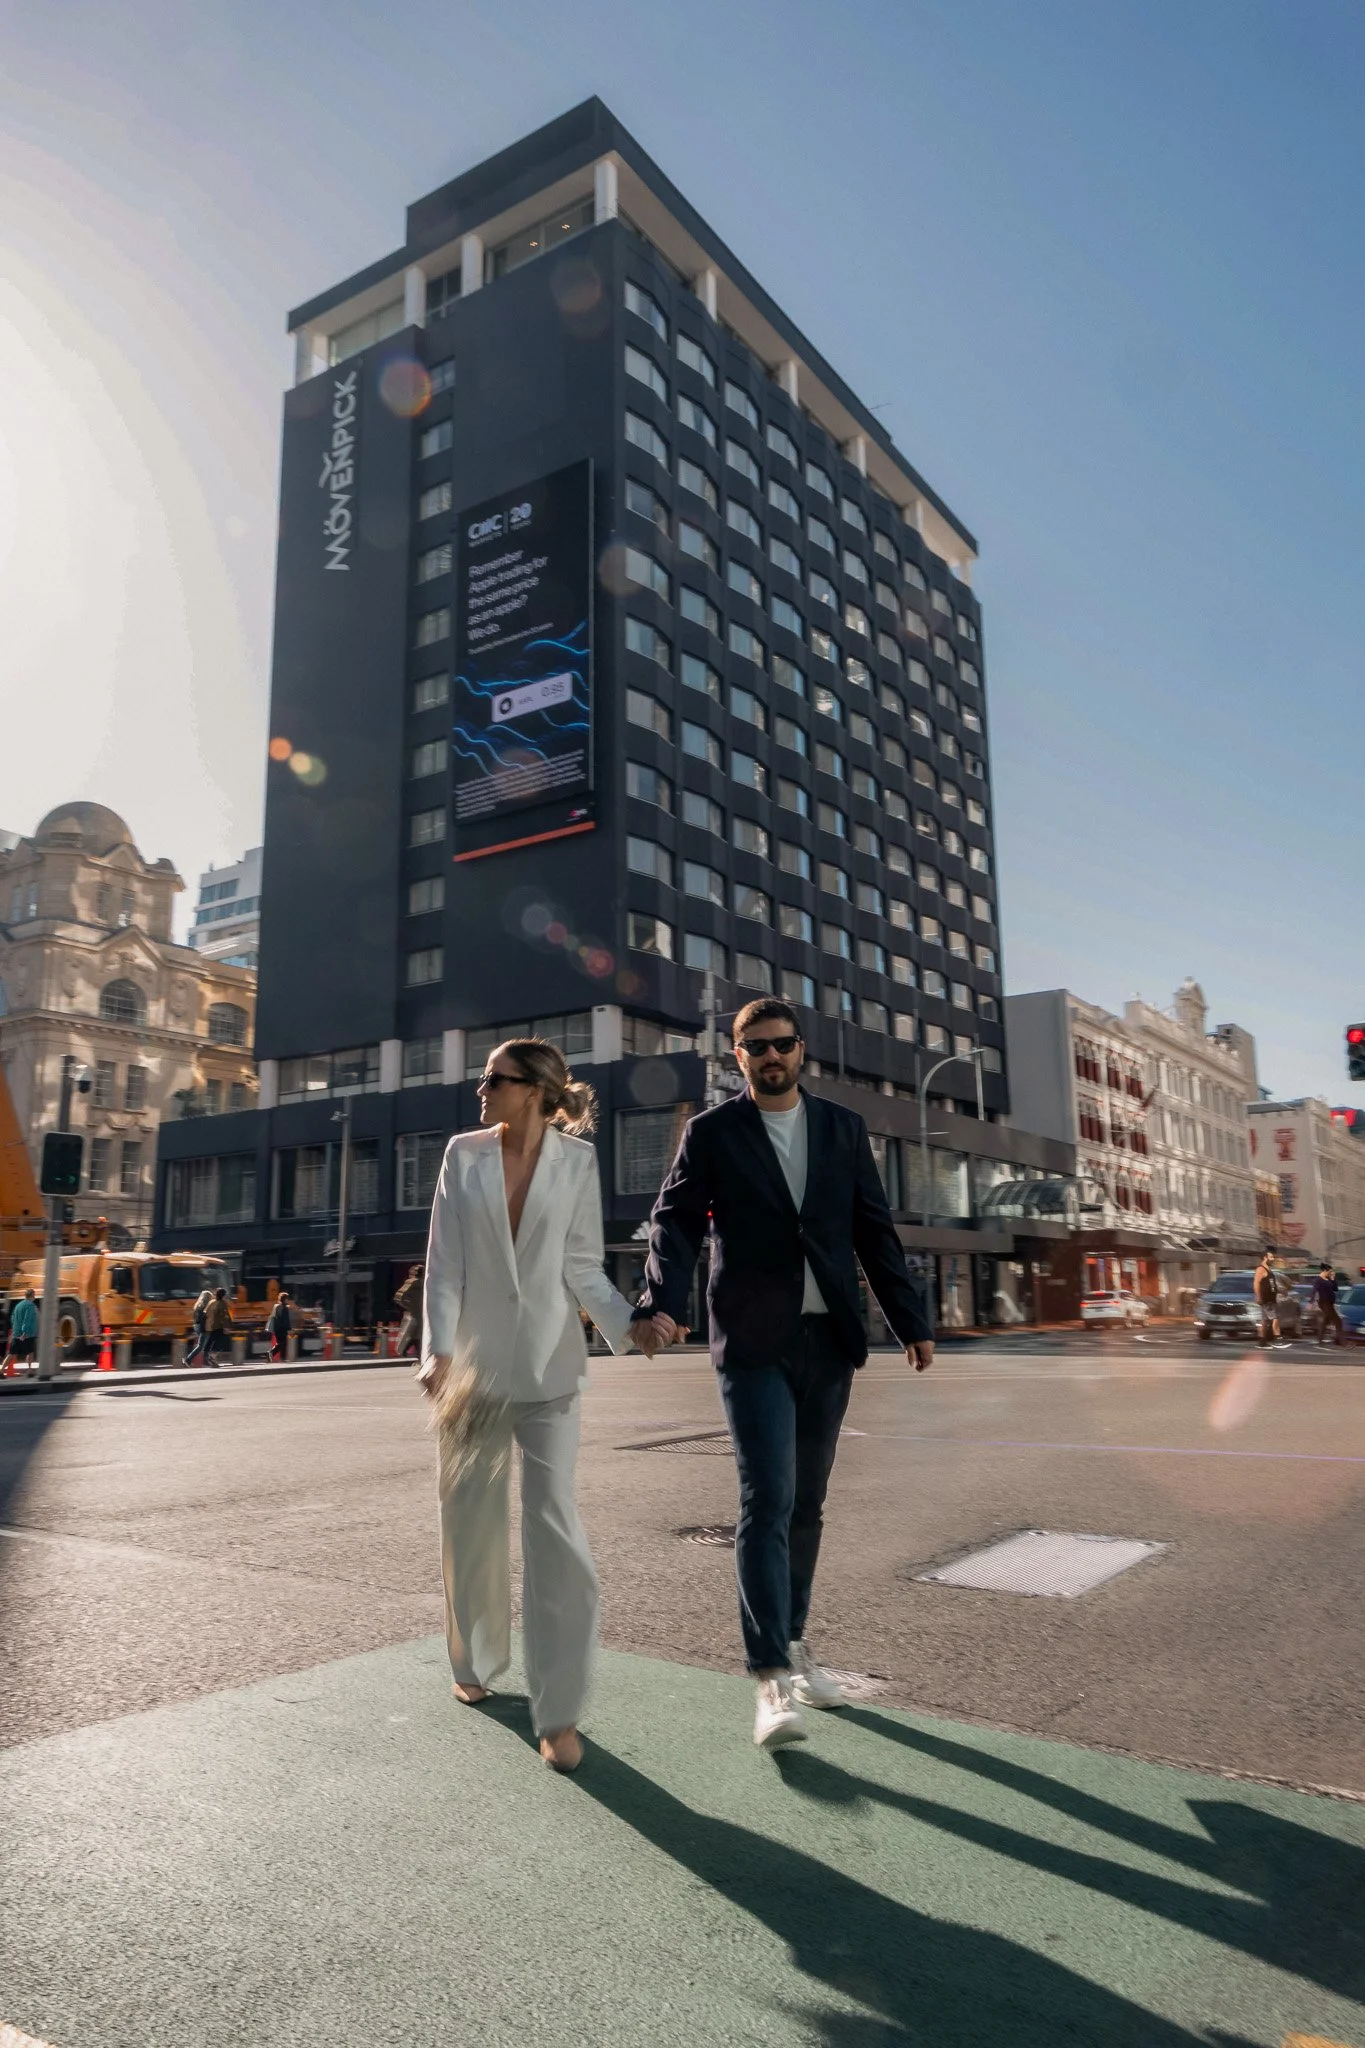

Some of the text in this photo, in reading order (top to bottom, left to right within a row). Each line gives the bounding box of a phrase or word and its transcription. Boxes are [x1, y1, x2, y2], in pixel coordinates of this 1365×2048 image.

[321, 370, 357, 571] MÖVENPICK
[468, 502, 533, 540] CMC 20
[468, 550, 524, 578] Remember
[468, 556, 549, 594] Apple trading for
[468, 596, 486, 609] the
[485, 586, 512, 604] same
[494, 594, 528, 616] apple?
